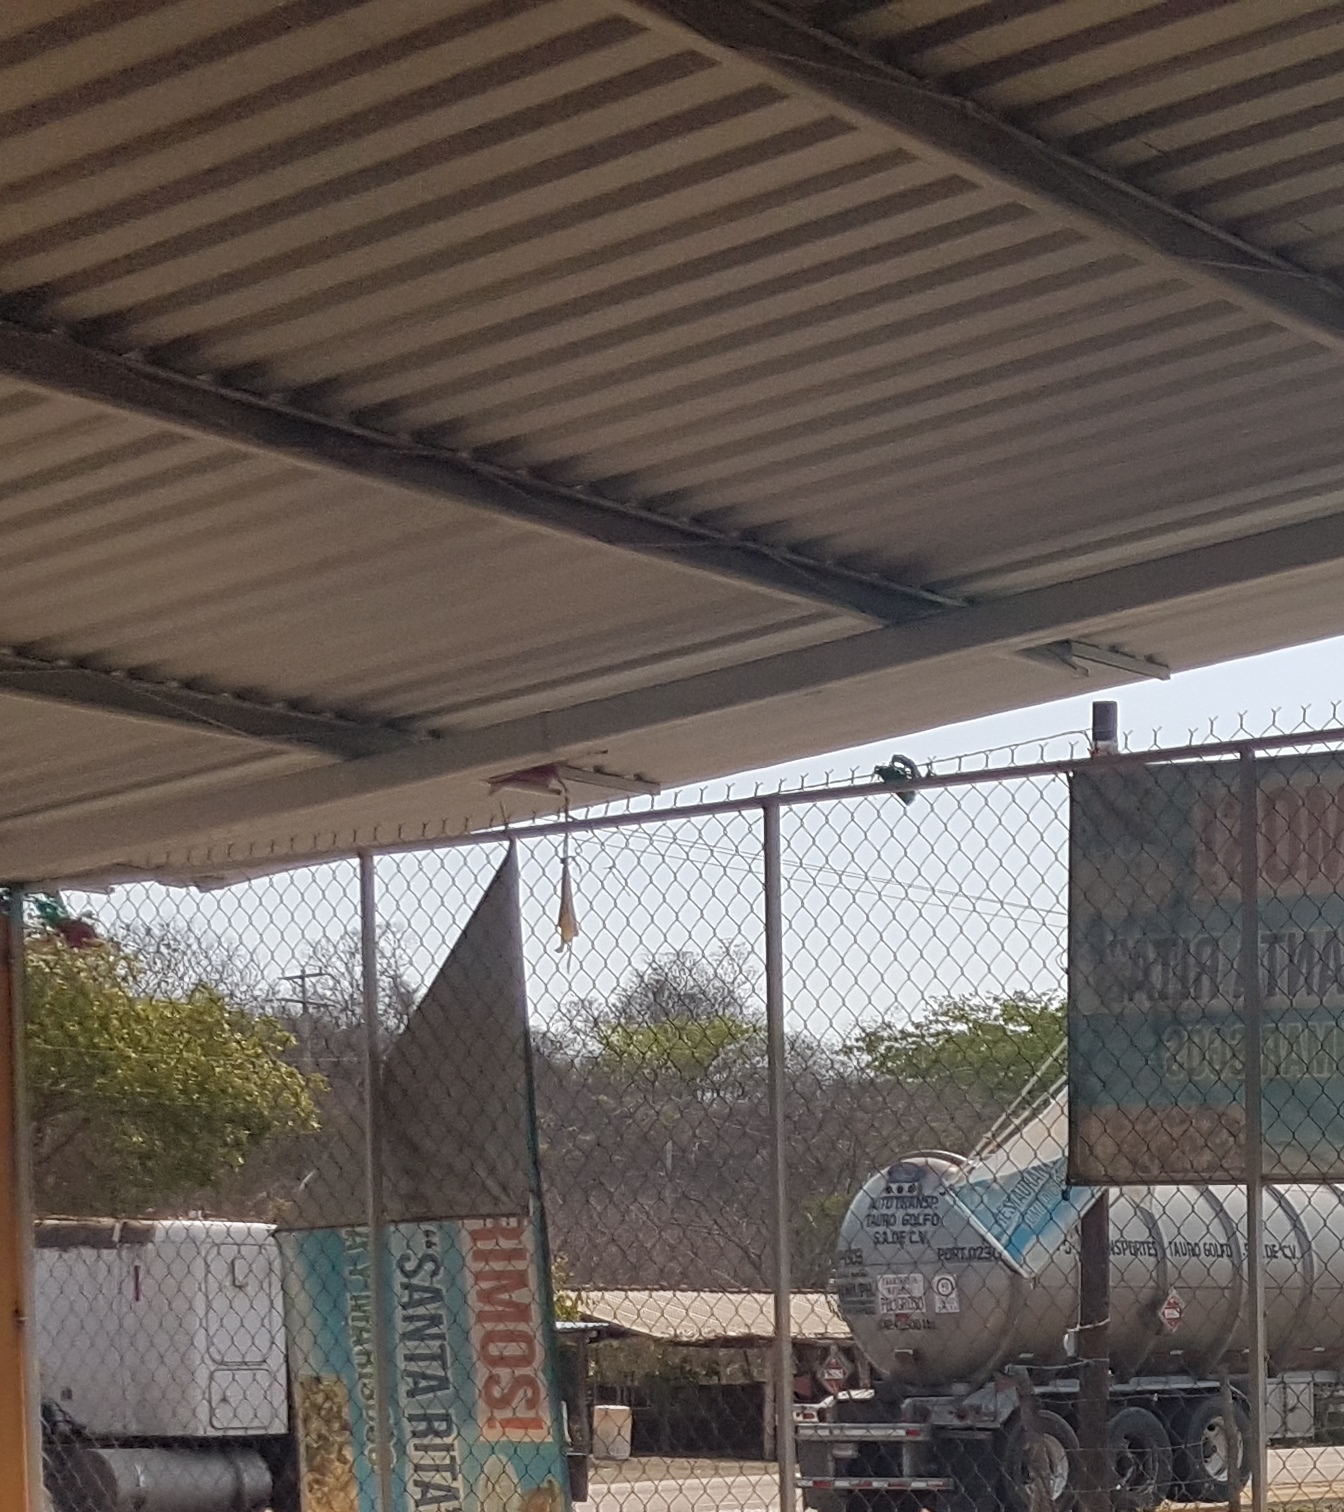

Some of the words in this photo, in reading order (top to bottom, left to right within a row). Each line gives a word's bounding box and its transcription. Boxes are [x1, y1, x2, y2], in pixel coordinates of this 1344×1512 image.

[866, 1213, 897, 1228] TAURO
[902, 1212, 940, 1227] GOLFO
[1168, 1241, 1200, 1257] TAURO
[1203, 1242, 1233, 1258] GOLFO
